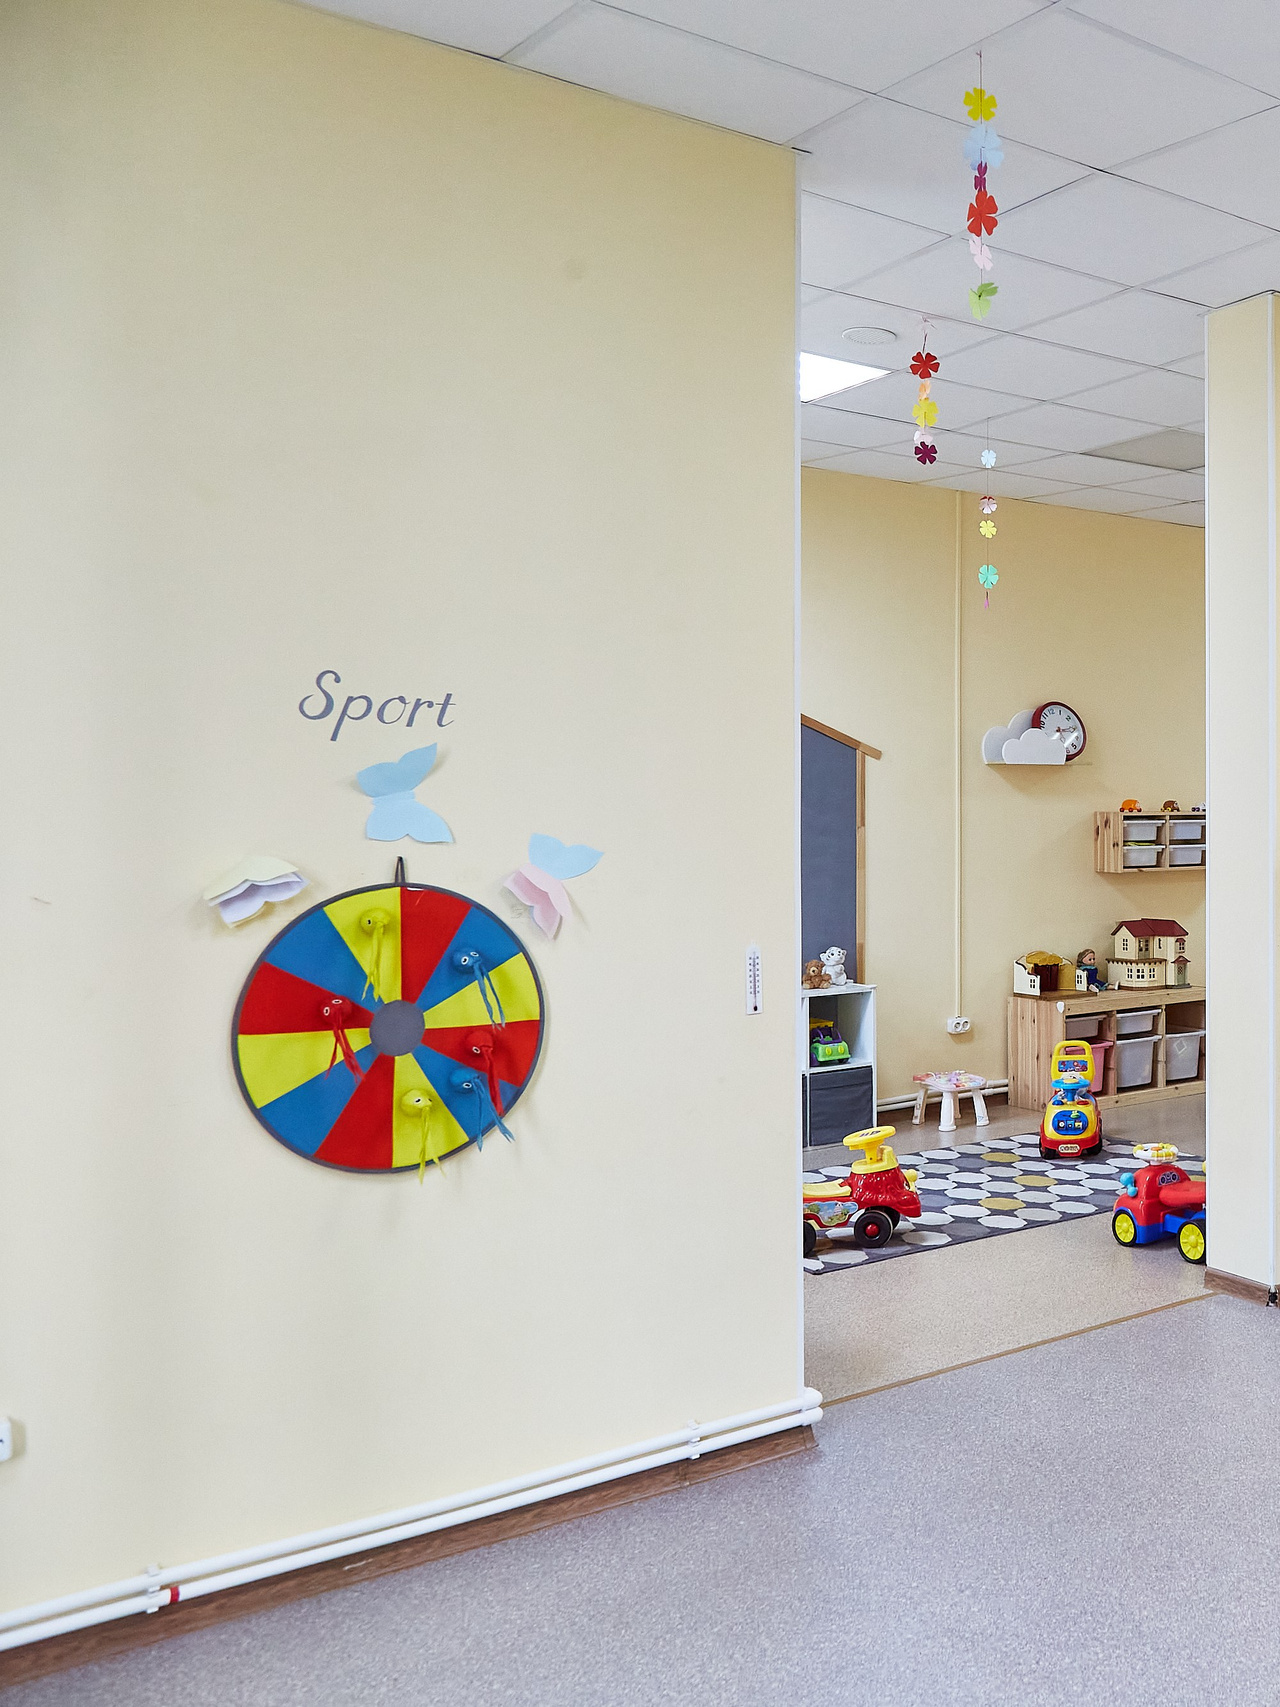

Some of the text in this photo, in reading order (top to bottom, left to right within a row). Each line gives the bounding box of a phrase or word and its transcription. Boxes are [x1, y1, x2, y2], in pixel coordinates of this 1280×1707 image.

[298, 669, 457, 742] Sport
[1042, 712, 1049, 720] 11
[1071, 742, 1077, 750] 5
